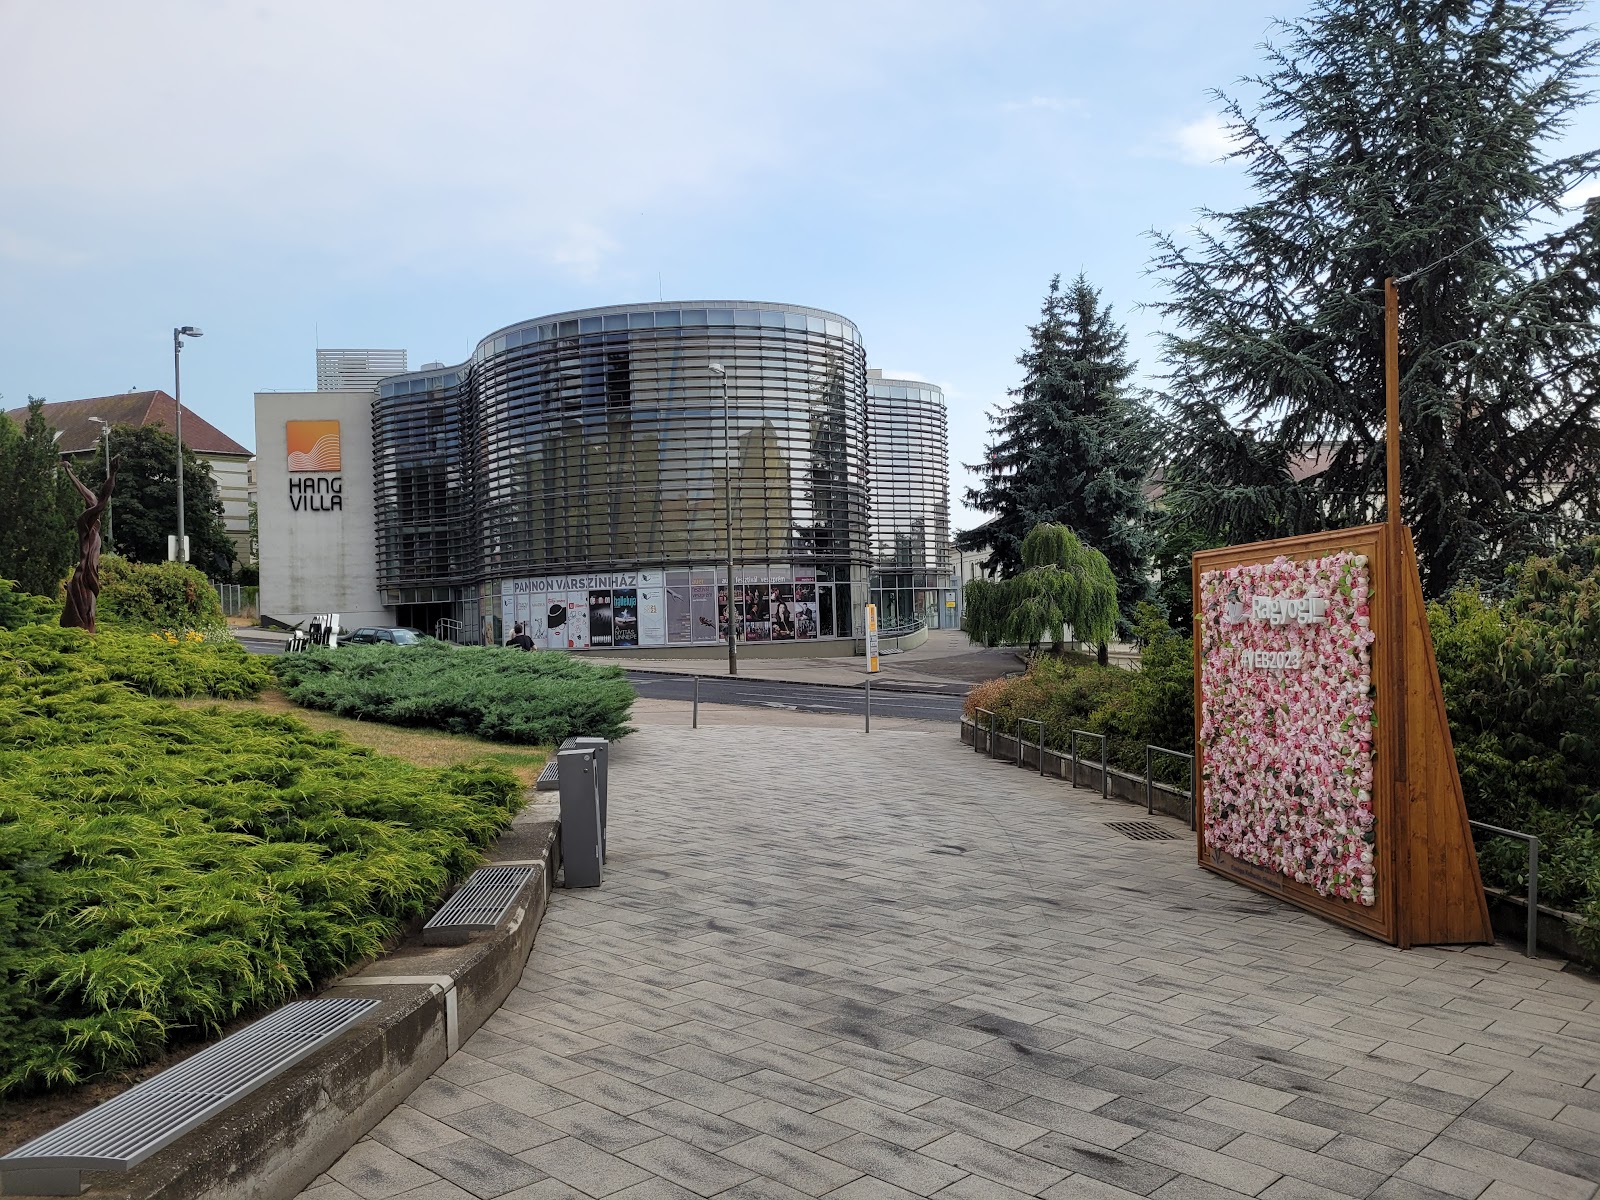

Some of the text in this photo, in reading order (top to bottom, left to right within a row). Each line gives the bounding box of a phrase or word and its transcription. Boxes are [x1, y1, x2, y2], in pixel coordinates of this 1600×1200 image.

[289, 477, 342, 494] HANG
[289, 495, 342, 511] VILLA
[514, 580, 554, 593] PANNON
[1241, 651, 1300, 669] #VEB2023
